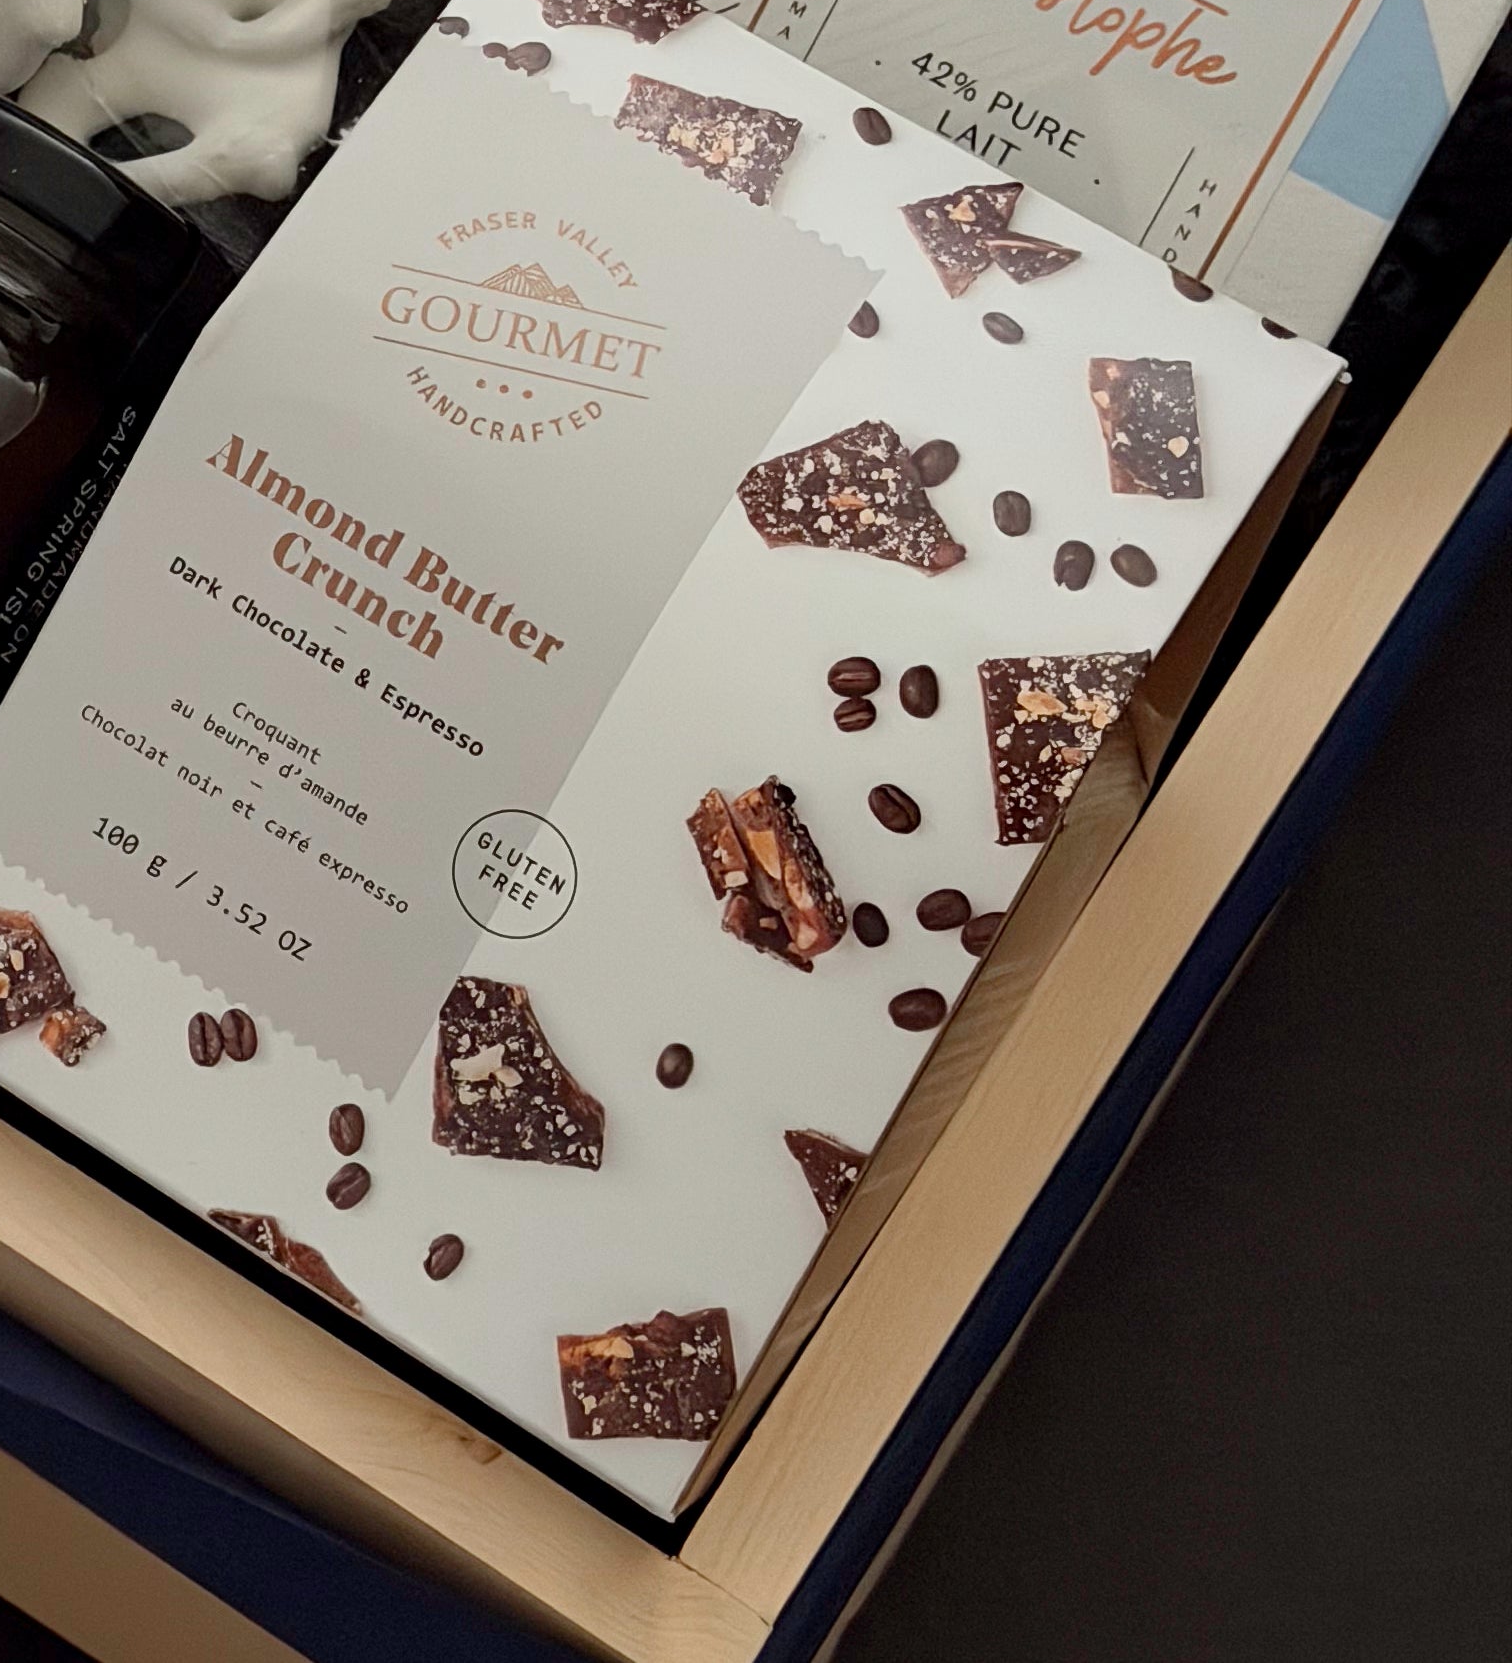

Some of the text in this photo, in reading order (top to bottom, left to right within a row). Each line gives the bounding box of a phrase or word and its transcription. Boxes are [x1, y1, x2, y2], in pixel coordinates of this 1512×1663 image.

[911, 52, 1086, 159] 42% PURE
[936, 109, 1022, 168] LAIT
[437, 211, 639, 290] FRASER VALLEY
[380, 286, 662, 380] GOURMET
[97, 405, 137, 479] SALT
[406, 365, 603, 443] HANDCRAFTED
[26, 478, 98, 582] SPRING
[205, 433, 566, 666] Almond Butter
[271, 531, 446, 660] Crunch
[0, 624, 29, 664] ON
[169, 555, 485, 758] Dark Chocolate & Espresso
[170, 696, 369, 827] au beurre d'amande
[231, 700, 324, 767] Croquant
[80, 703, 410, 915] Chocolat noir et café expresso
[91, 815, 314, 963] 100 g / 3.52 OZ
[476, 830, 568, 896] GLUTEN
[476, 862, 539, 911] FREE
